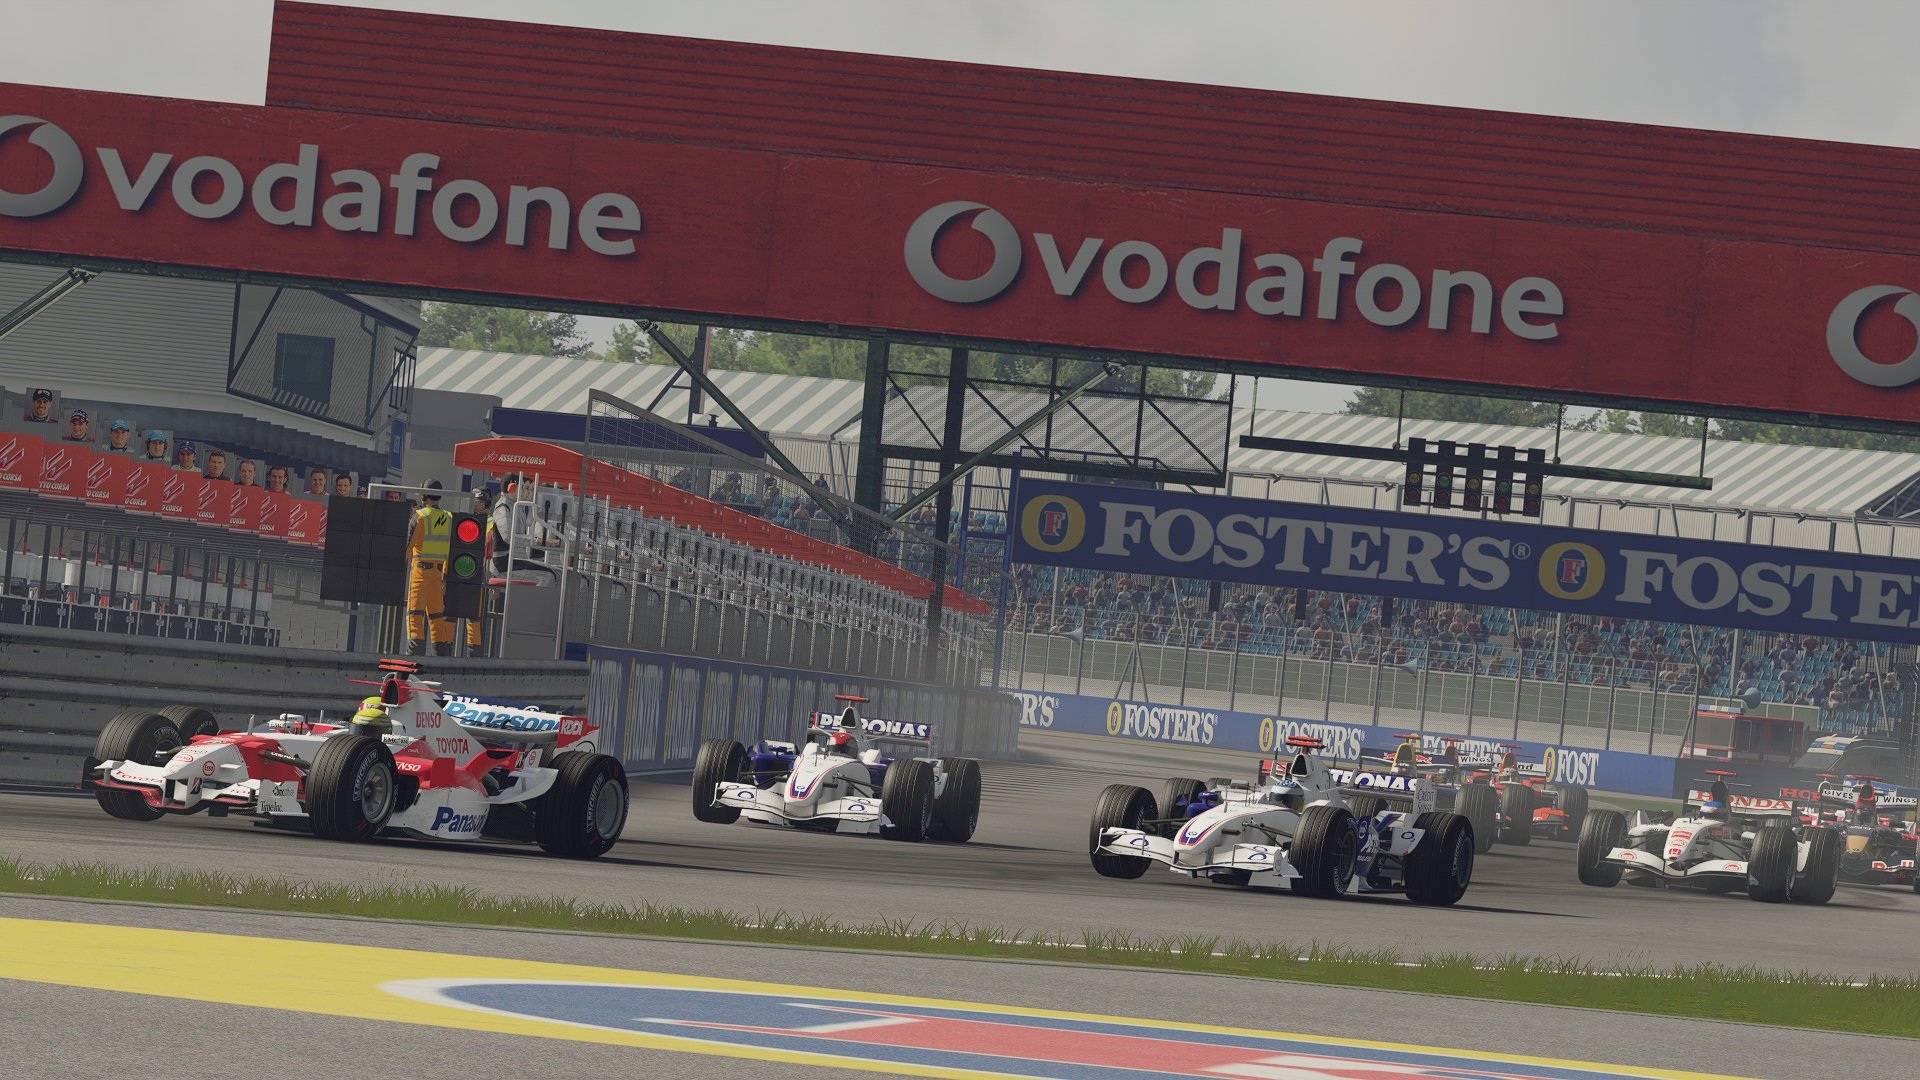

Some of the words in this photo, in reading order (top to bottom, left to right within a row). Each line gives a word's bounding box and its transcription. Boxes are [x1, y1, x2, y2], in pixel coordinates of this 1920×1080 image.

[97, 143, 642, 256] vodafone
[1033, 228, 1565, 341] vodafone
[499, 454, 526, 463] ASSETTO
[526, 456, 547, 465] CORSA
[1615, 549, 1920, 630] FOSTE
[415, 712, 441, 728] DENSO
[560, 719, 583, 735] KDDI
[436, 738, 470, 754] TOYOTA
[1555, 749, 1600, 785] FOST
[1824, 790, 1854, 800] GIVES
[1882, 796, 1917, 804] WINGS
